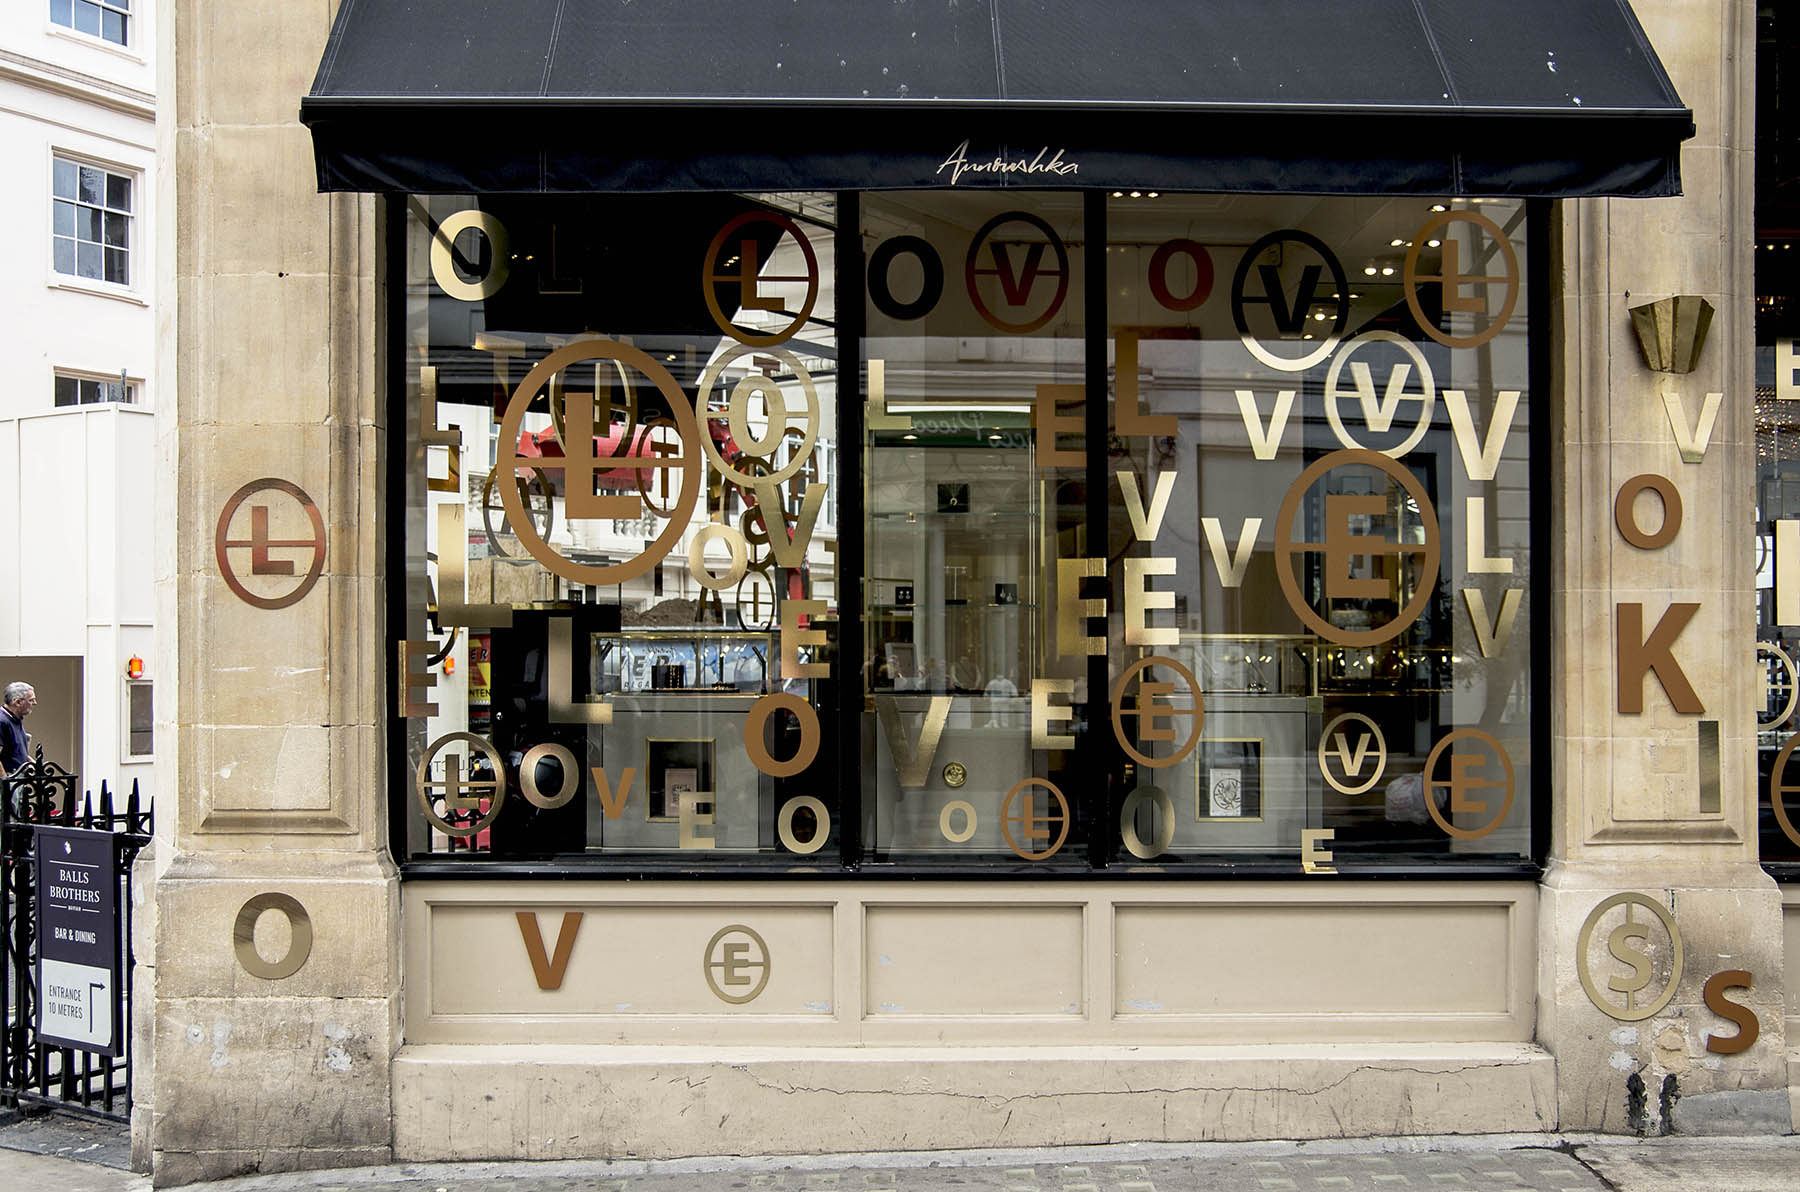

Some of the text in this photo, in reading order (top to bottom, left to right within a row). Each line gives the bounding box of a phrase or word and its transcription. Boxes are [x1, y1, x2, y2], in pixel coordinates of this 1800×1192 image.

[430, 209, 510, 301] O
[741, 239, 785, 311] L
[867, 235, 944, 320] O
[989, 241, 1046, 306] V
[1148, 238, 1214, 312] O
[1441, 240, 1486, 312] L
[1257, 265, 1323, 337] V
[728, 376, 786, 457] O
[867, 359, 911, 430] L
[1115, 330, 1179, 436] L
[1351, 362, 1412, 432] V
[565, 392, 641, 519] L
[1036, 384, 1087, 467] E
[1235, 391, 1296, 460] V
[1442, 391, 1521, 481] V
[1661, 393, 1723, 464] V
[252, 506, 294, 575] L
[753, 483, 828, 568] V
[1116, 472, 1178, 541] V
[1466, 497, 1513, 573] L
[1615, 474, 1683, 550] O
[438, 504, 513, 628] L
[689, 524, 748, 590] O
[1201, 518, 1263, 587] V
[1326, 496, 1390, 598] E
[1056, 558, 1107, 655] E
[1124, 558, 1180, 645] E
[1462, 589, 1524, 658] V
[548, 617, 613, 723] L
[781, 600, 830, 678] E
[1617, 603, 1706, 713] K
[744, 693, 821, 778] O
[875, 696, 953, 787] V
[1032, 679, 1075, 750] E
[1140, 682, 1176, 740] E
[445, 754, 480, 809] L
[520, 743, 579, 809] O
[1333, 733, 1372, 777] V
[1451, 754, 1487, 812] E
[592, 767, 636, 819] V
[680, 791, 716, 849] E
[778, 795, 831, 855] O
[939, 800, 978, 843] O
[1023, 796, 1050, 838] L
[1120, 784, 1175, 860] O
[59, 869, 90, 884] BALLS
[1302, 829, 1338, 874] E
[49, 885, 101, 903] BROTHERS
[54, 926, 96, 945] BAR & DINING
[233, 892, 313, 980] O
[515, 911, 584, 991] V
[723, 942, 751, 986] E
[48, 984, 82, 1002] ENTRANCE
[48, 1001, 83, 1020] 10 METRES
[1703, 969, 1760, 1055] S
